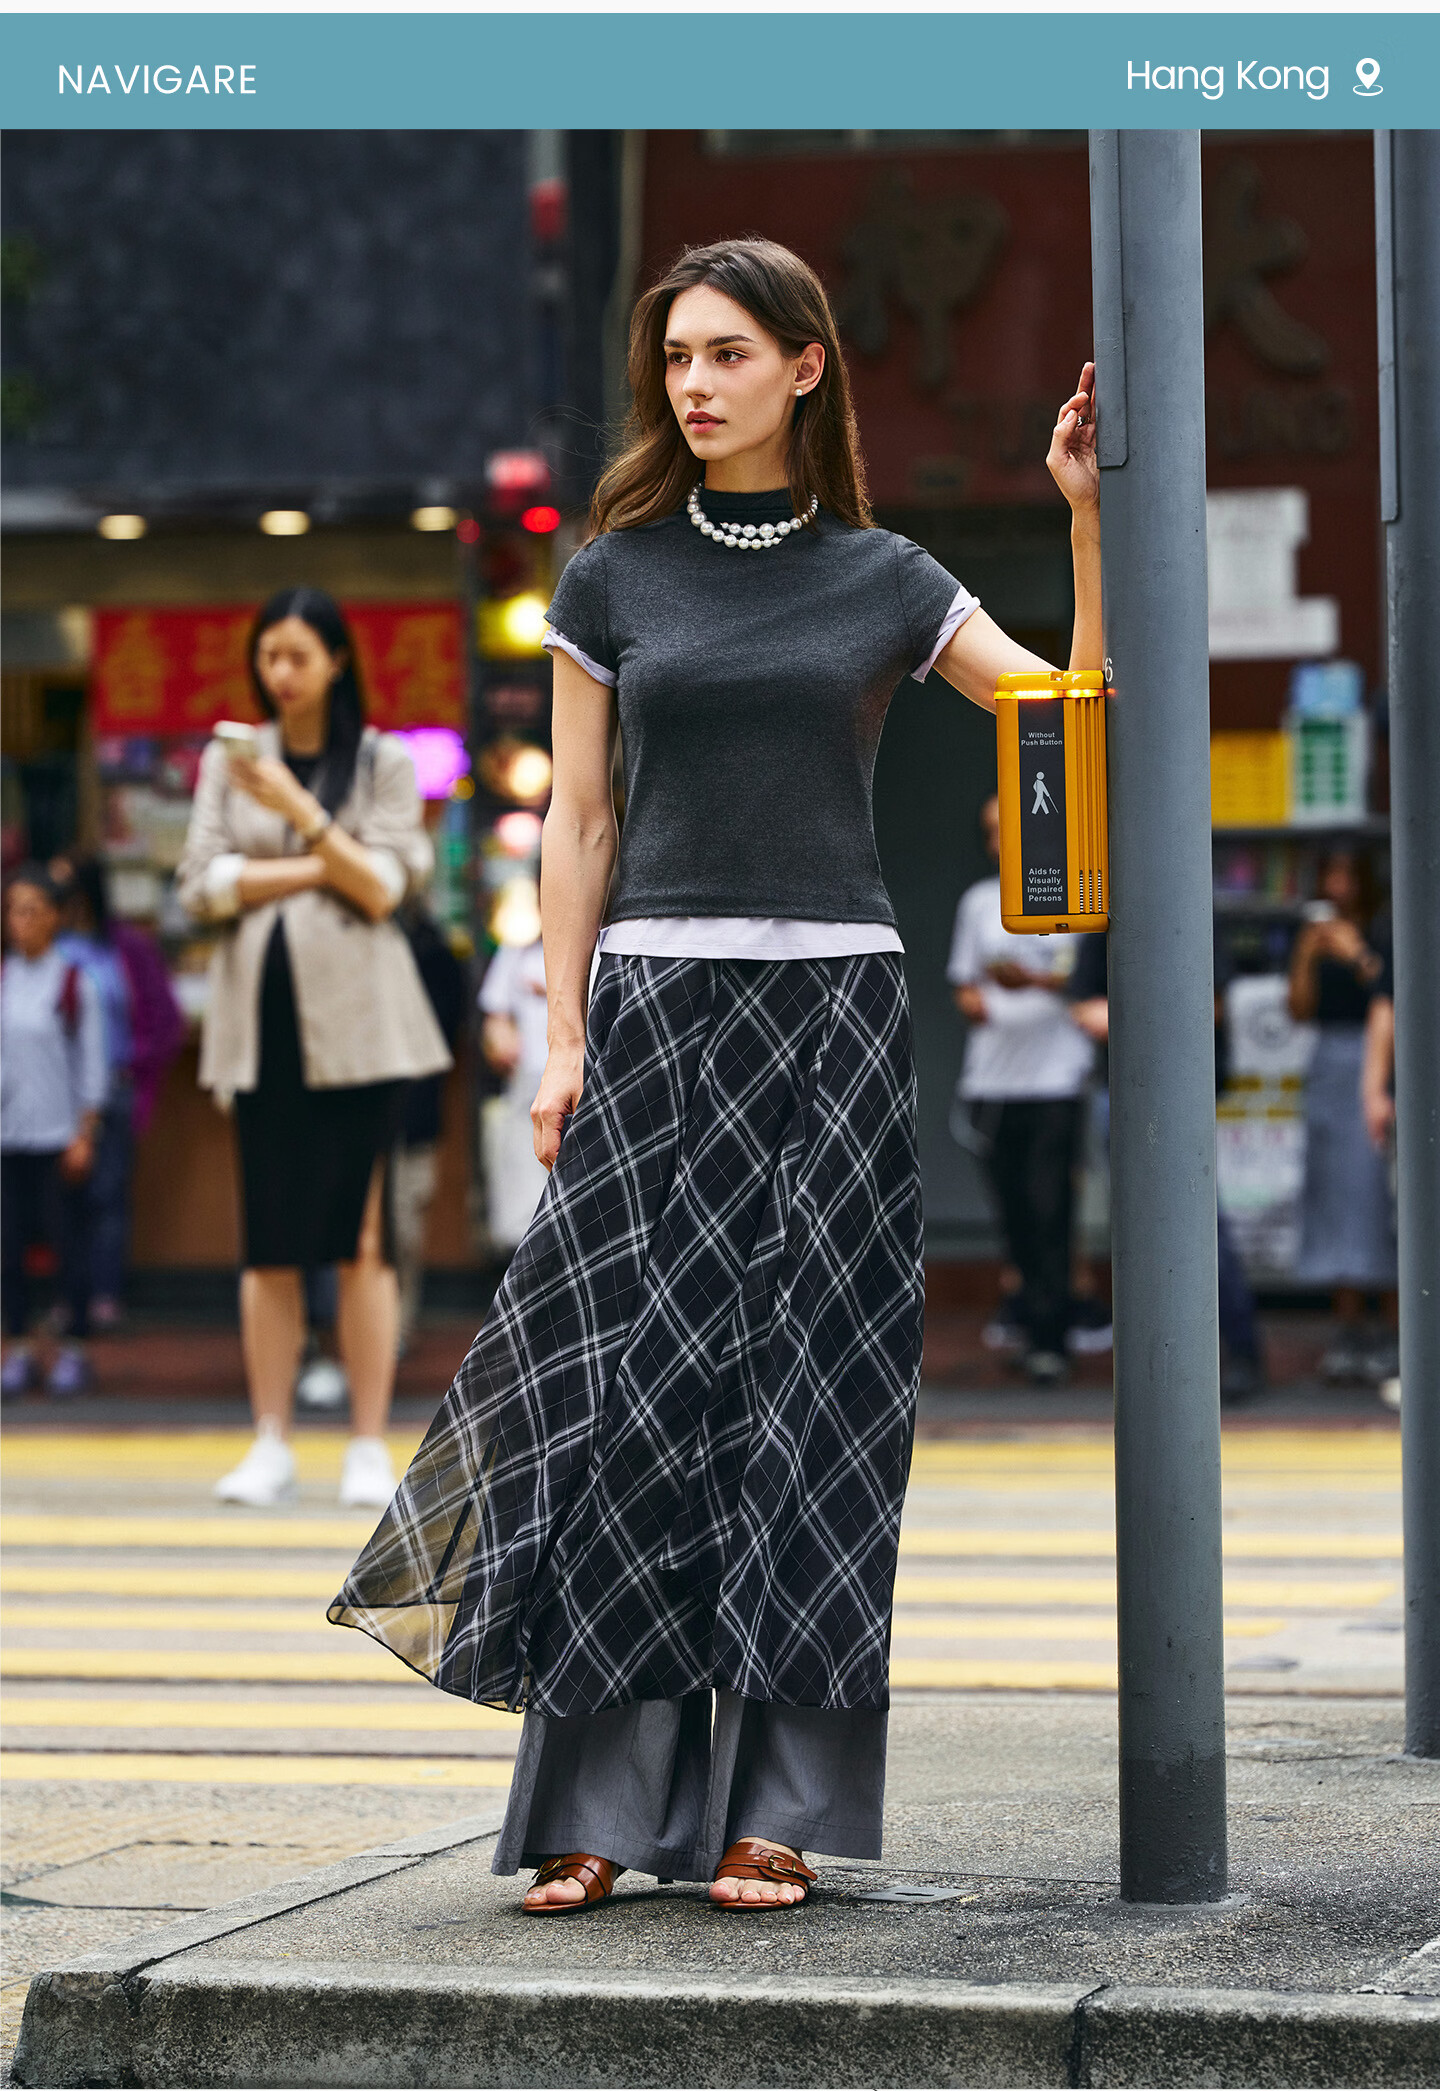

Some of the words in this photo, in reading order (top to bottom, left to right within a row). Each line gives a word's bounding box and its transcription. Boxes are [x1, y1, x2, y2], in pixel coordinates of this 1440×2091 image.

[1104, 657, 1114, 683] 6
[1028, 867, 1047, 875] Aids
[1048, 867, 1061, 875] for
[1028, 876, 1062, 885] Visually
[1027, 885, 1063, 894] Impaired
[1028, 894, 1062, 902] Persons
